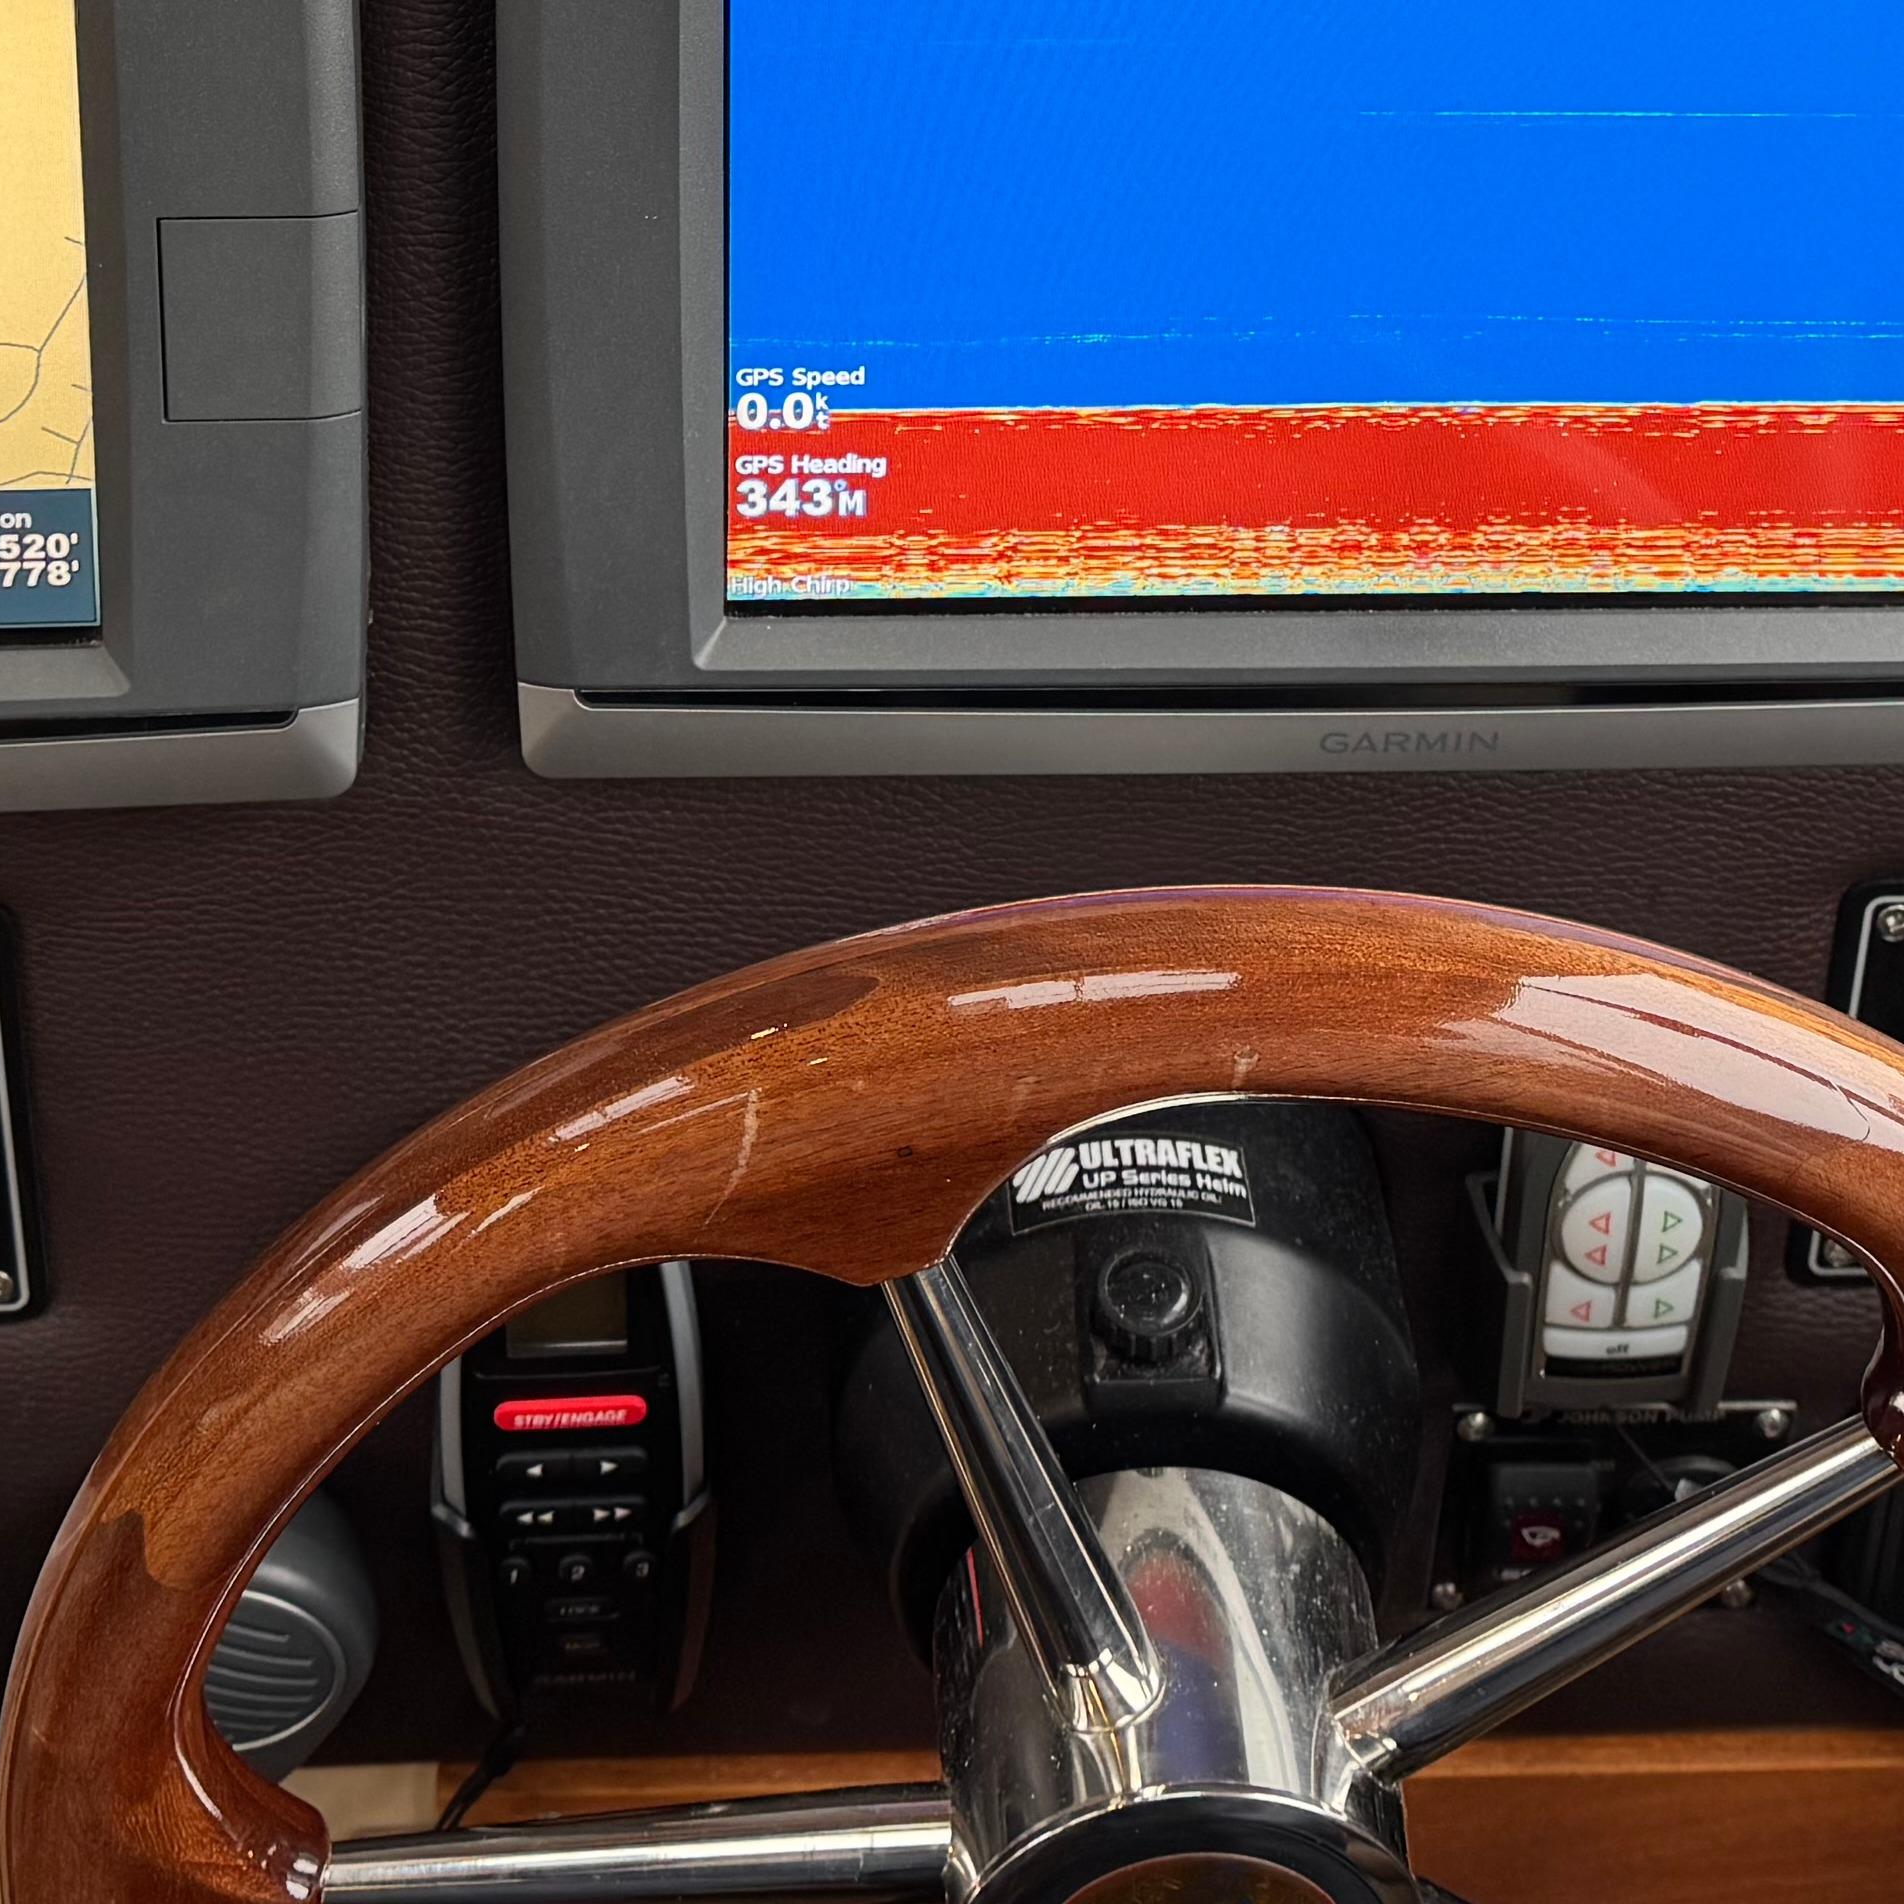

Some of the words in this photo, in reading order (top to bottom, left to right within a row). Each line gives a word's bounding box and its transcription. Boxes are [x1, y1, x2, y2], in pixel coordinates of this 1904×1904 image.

[736, 367, 784, 387] GPS
[792, 366, 866, 390] Speed
[735, 455, 784, 475] GPS
[791, 452, 888, 478] Heading
[731, 575, 783, 597] High
[791, 574, 850, 596] Chirp
[1320, 731, 1500, 754] GARMIN
[1079, 1138, 1243, 1179] ULTRAFLEX
[1082, 1170, 1117, 1190] UP
[1121, 1169, 1192, 1187] Series
[1196, 1173, 1248, 1199] Helm
[571, 1564, 586, 1582] 2
[637, 1561, 649, 1579] 3
